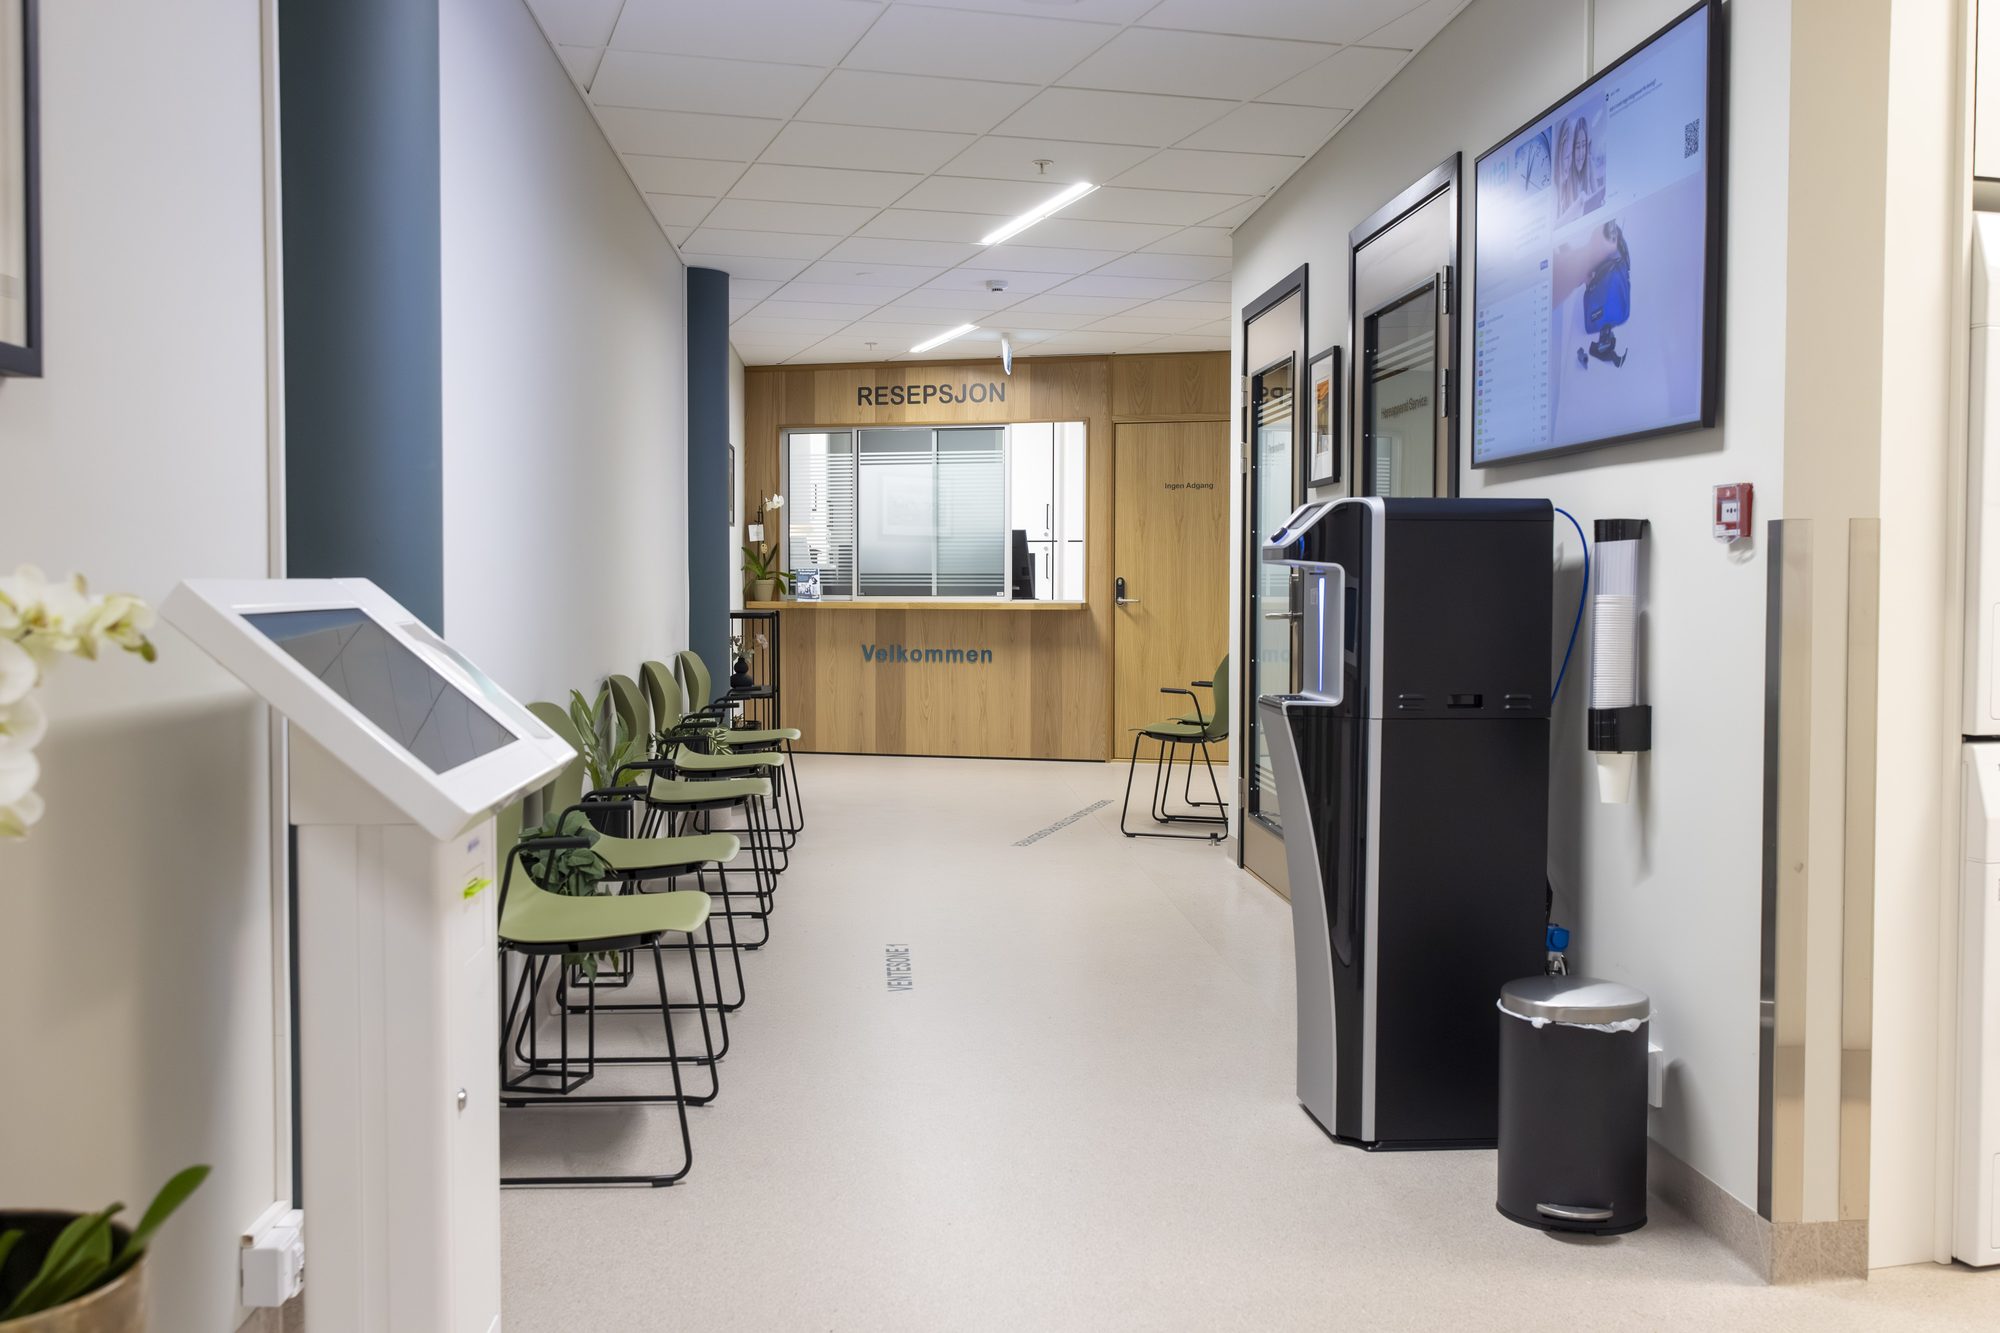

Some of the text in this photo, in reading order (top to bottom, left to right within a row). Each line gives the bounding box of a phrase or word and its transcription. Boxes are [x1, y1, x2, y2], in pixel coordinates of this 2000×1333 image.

[857, 382, 1005, 406] RESEPSJON
[1164, 482, 1214, 490] Ingen Adgang
[861, 644, 993, 663] Velkommen
[886, 948, 912, 991] VENTESONE
